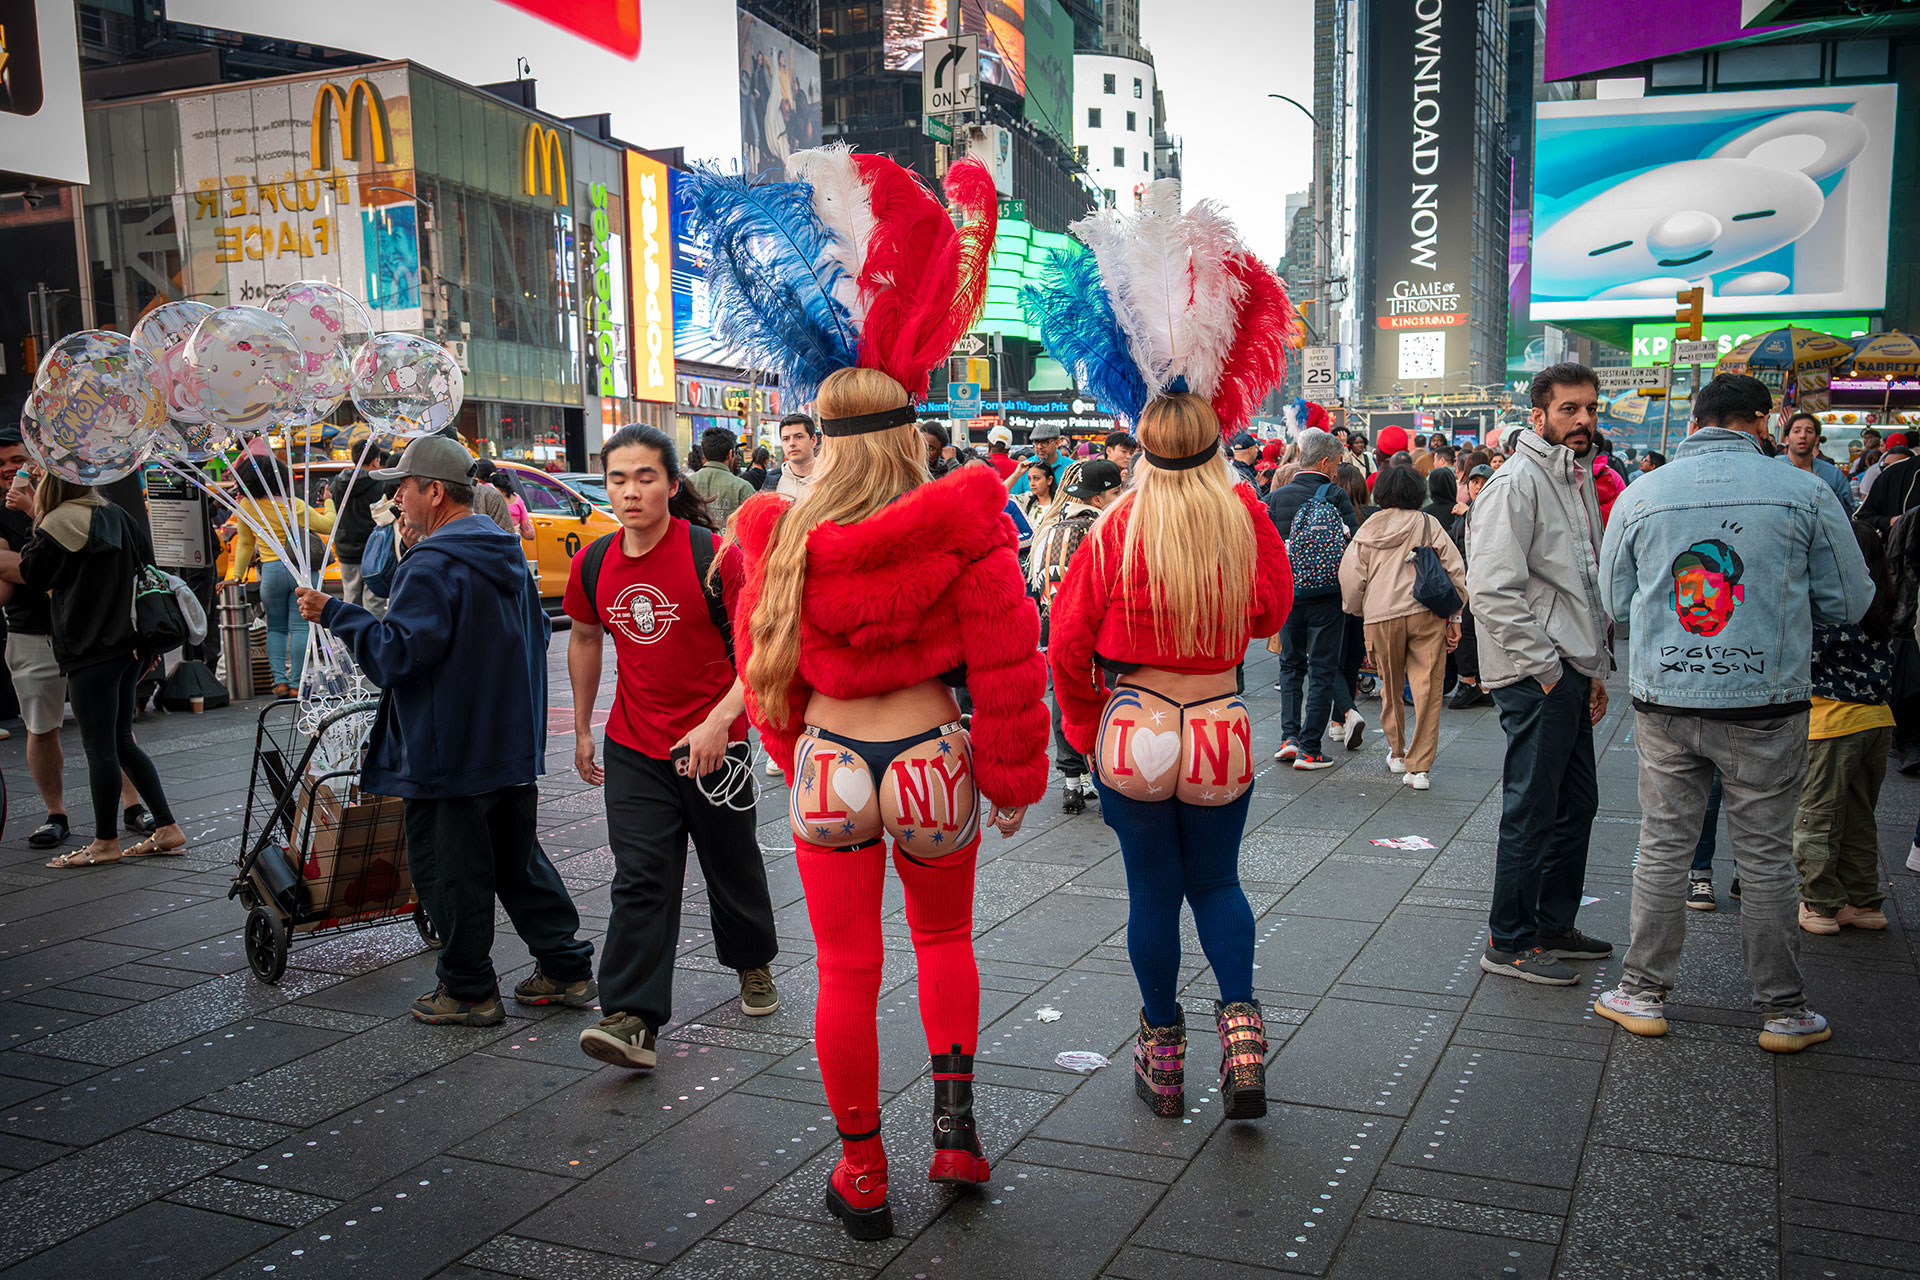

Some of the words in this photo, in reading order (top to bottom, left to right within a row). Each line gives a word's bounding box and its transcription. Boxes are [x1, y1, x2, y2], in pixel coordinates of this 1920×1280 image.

[932, 90, 969, 107] ONLY
[1410, 183, 1439, 271] NOW
[591, 181, 616, 398] popeyes
[1393, 280, 1441, 299] GAME
[1443, 282, 1455, 293] OF
[1386, 297, 1459, 316] THRONES
[1391, 315, 1455, 327] KINGSROAD
[959, 340, 978, 350] WAY
[1307, 368, 1331, 384] 25
[1857, 361, 1920, 373] SABRETT
[700, 383, 722, 410] NY
[1051, 402, 1069, 412] Prix
[1112, 718, 1136, 777] I
[1186, 716, 1254, 787] NY
[805, 751, 847, 824] I
[891, 752, 970, 832] NY
